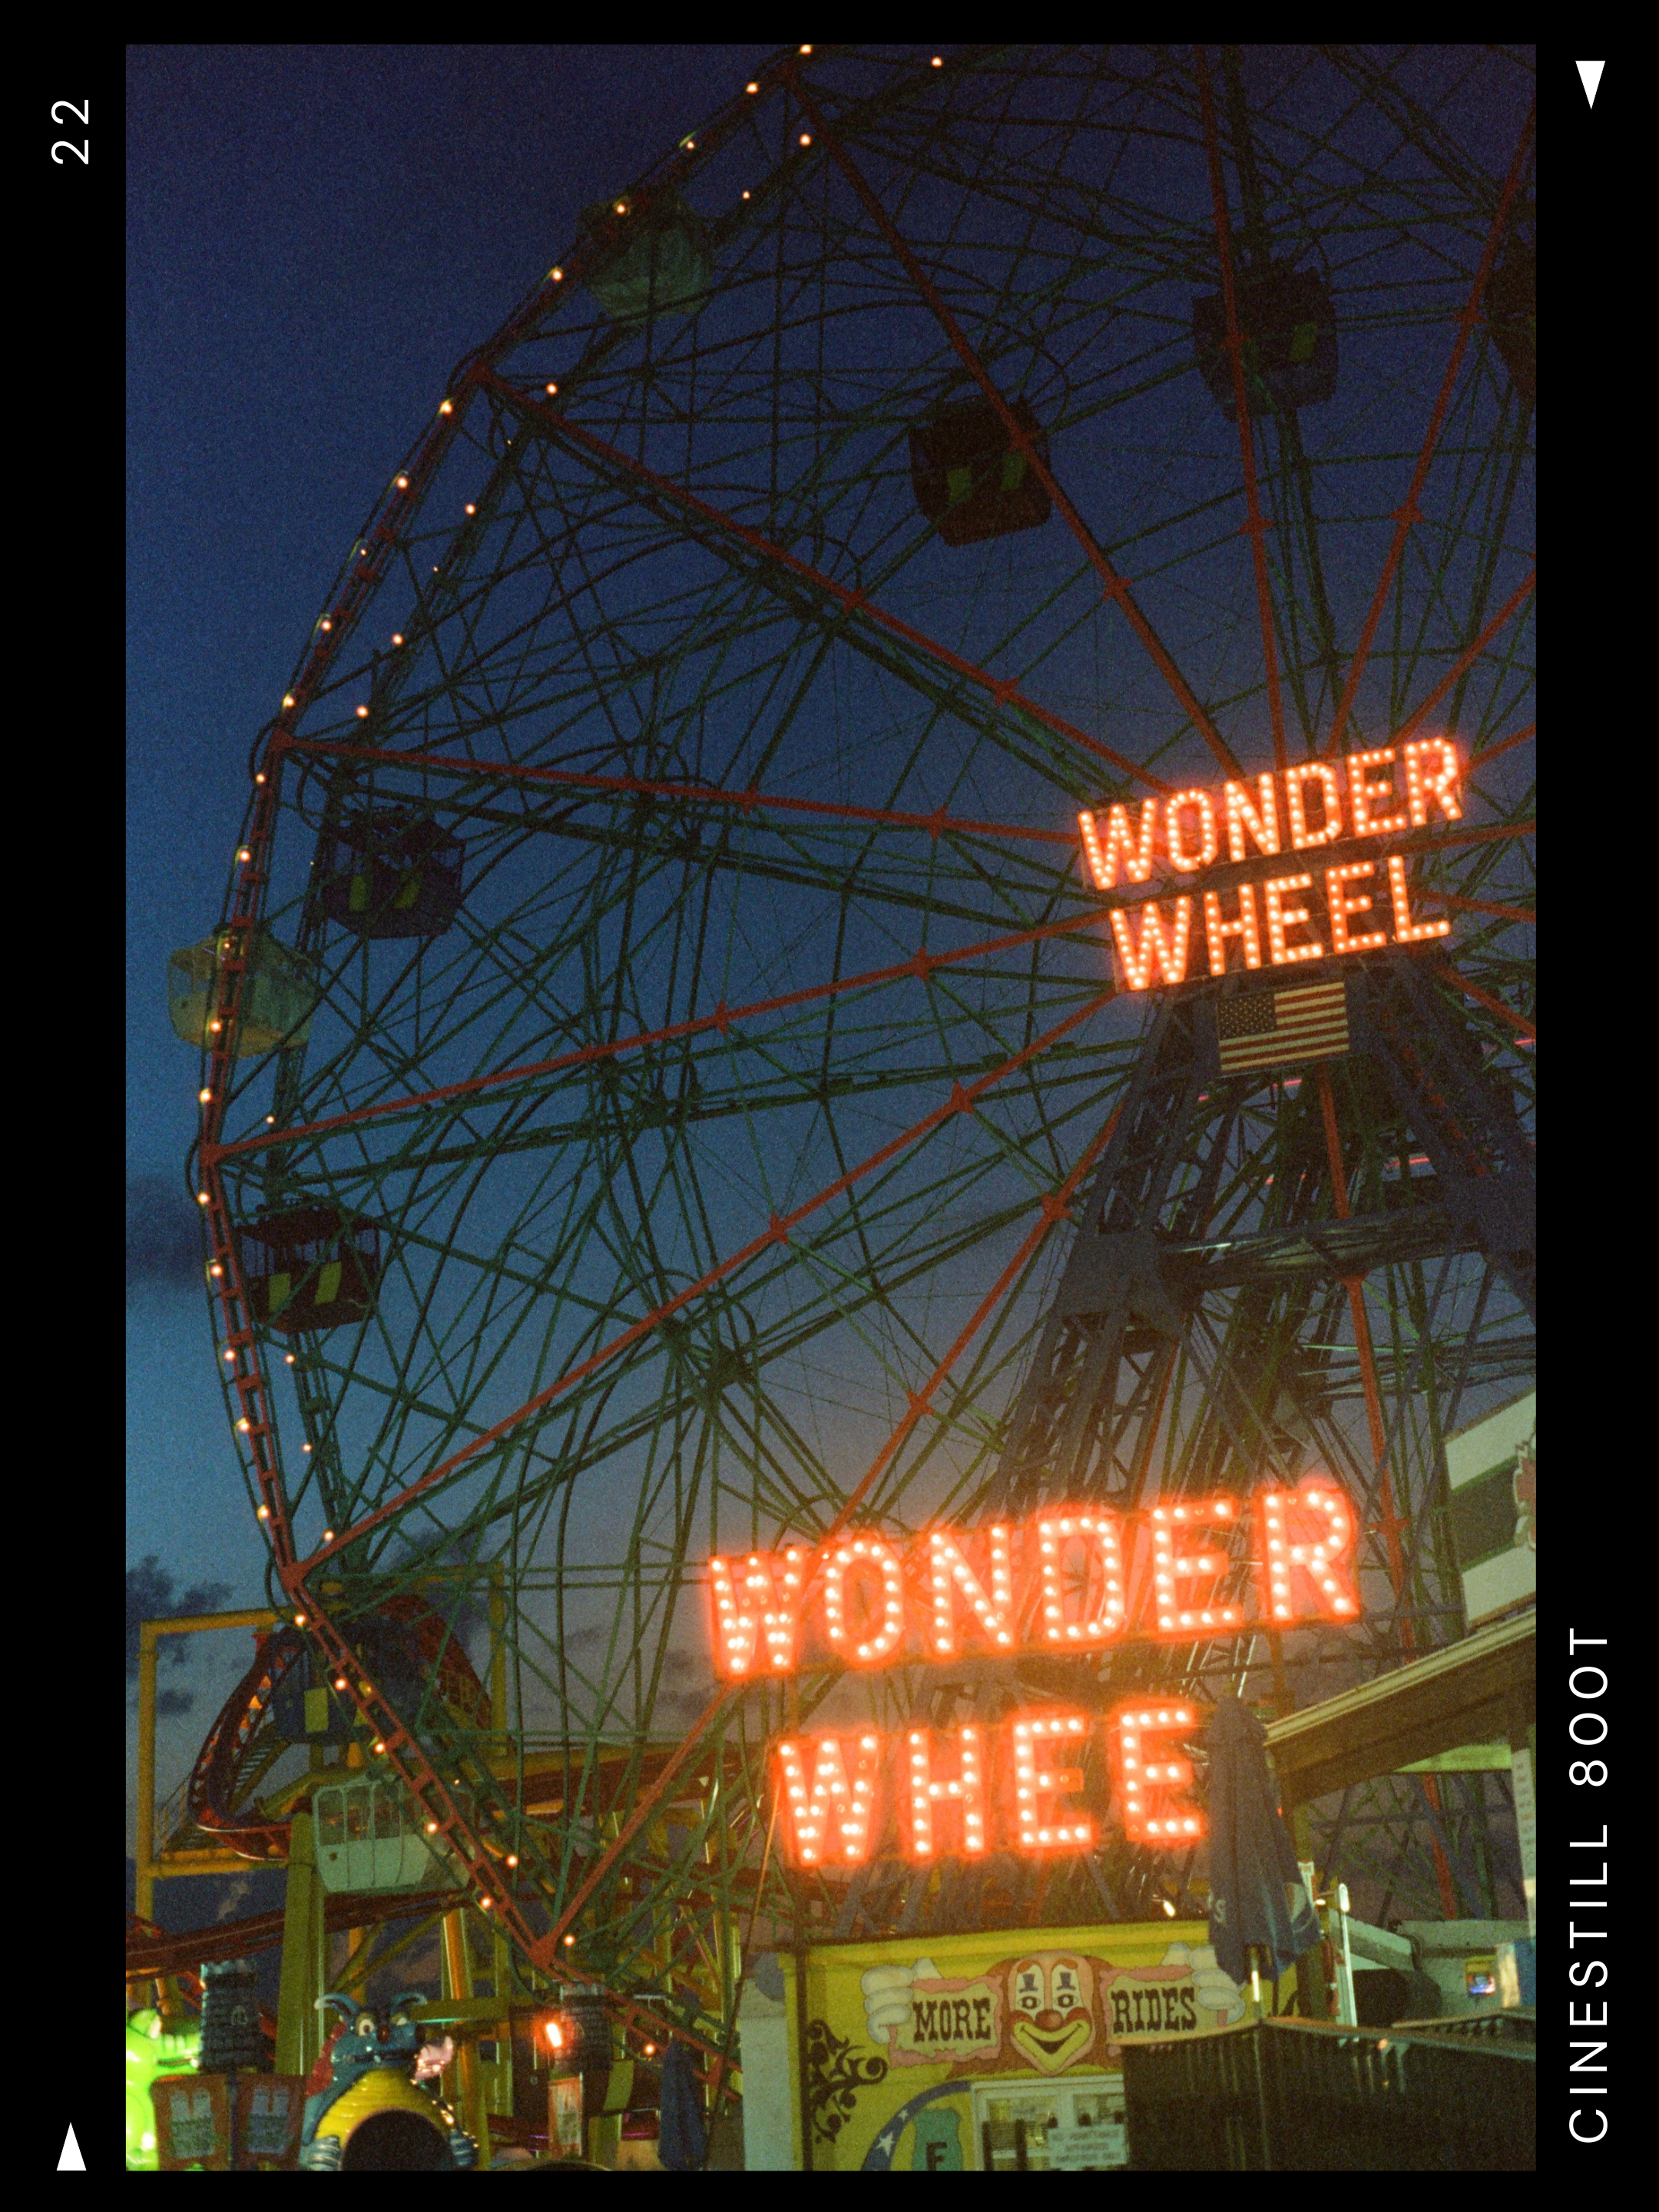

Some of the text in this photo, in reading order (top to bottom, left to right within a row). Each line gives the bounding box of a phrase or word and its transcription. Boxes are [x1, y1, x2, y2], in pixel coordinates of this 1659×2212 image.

[1078, 737, 1462, 889] WONDER
[1110, 856, 1451, 991] WHEEL
[708, 1486, 1359, 1680] WONDER
[776, 1701, 1205, 1866] WHEE
[912, 1987, 1199, 2041] MORE RIDES
